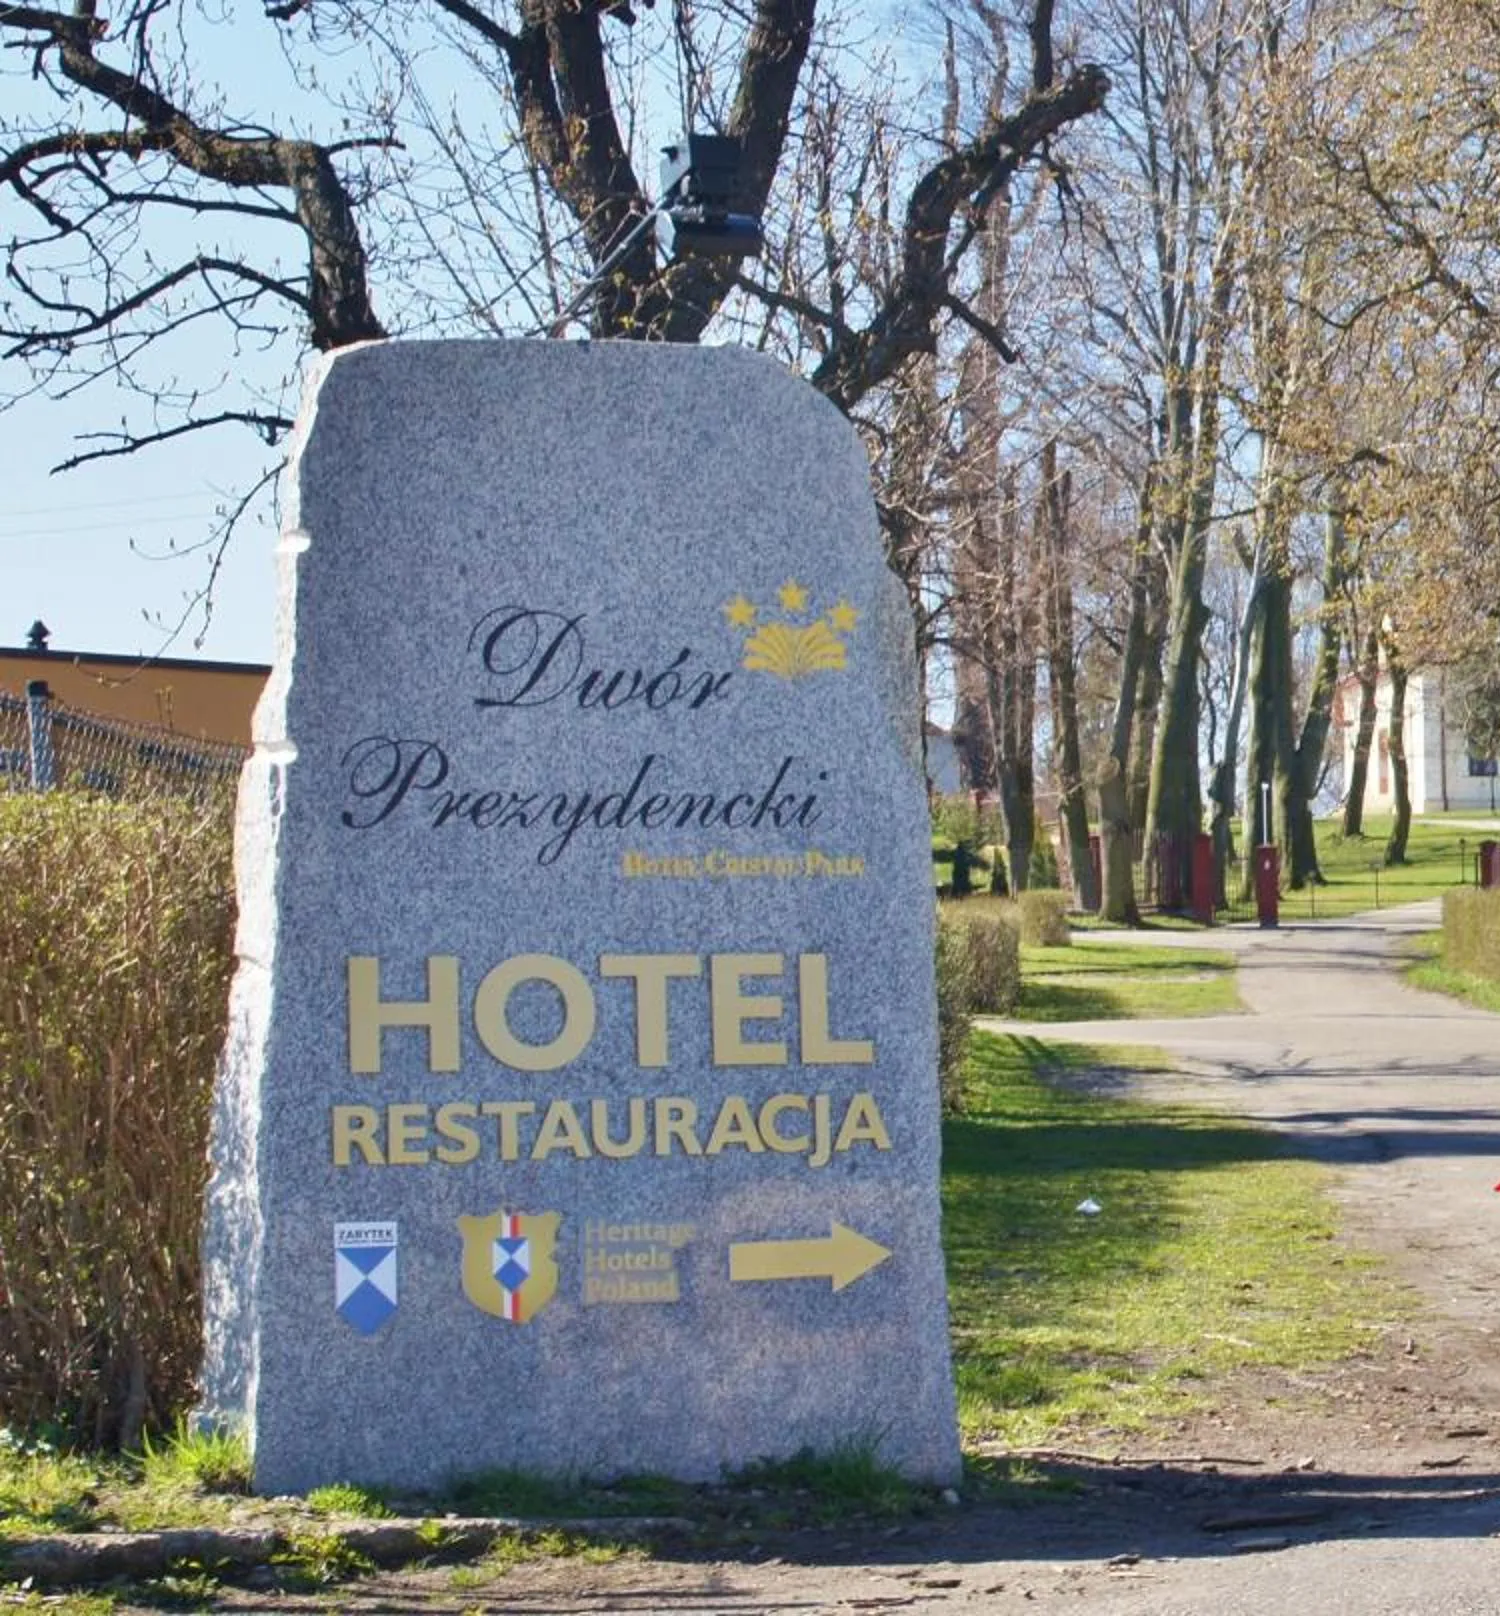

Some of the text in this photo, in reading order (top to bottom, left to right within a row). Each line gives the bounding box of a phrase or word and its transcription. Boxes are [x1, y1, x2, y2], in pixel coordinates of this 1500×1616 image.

[467, 605, 733, 709] Dwór
[340, 735, 828, 865] Prezydencki
[348, 953, 873, 1073] HOTEL
[332, 1093, 892, 1169] RESTAURACJA
[584, 1246, 673, 1271] Hotels
[585, 1218, 697, 1248] Heritage
[583, 1276, 680, 1303] Poland
